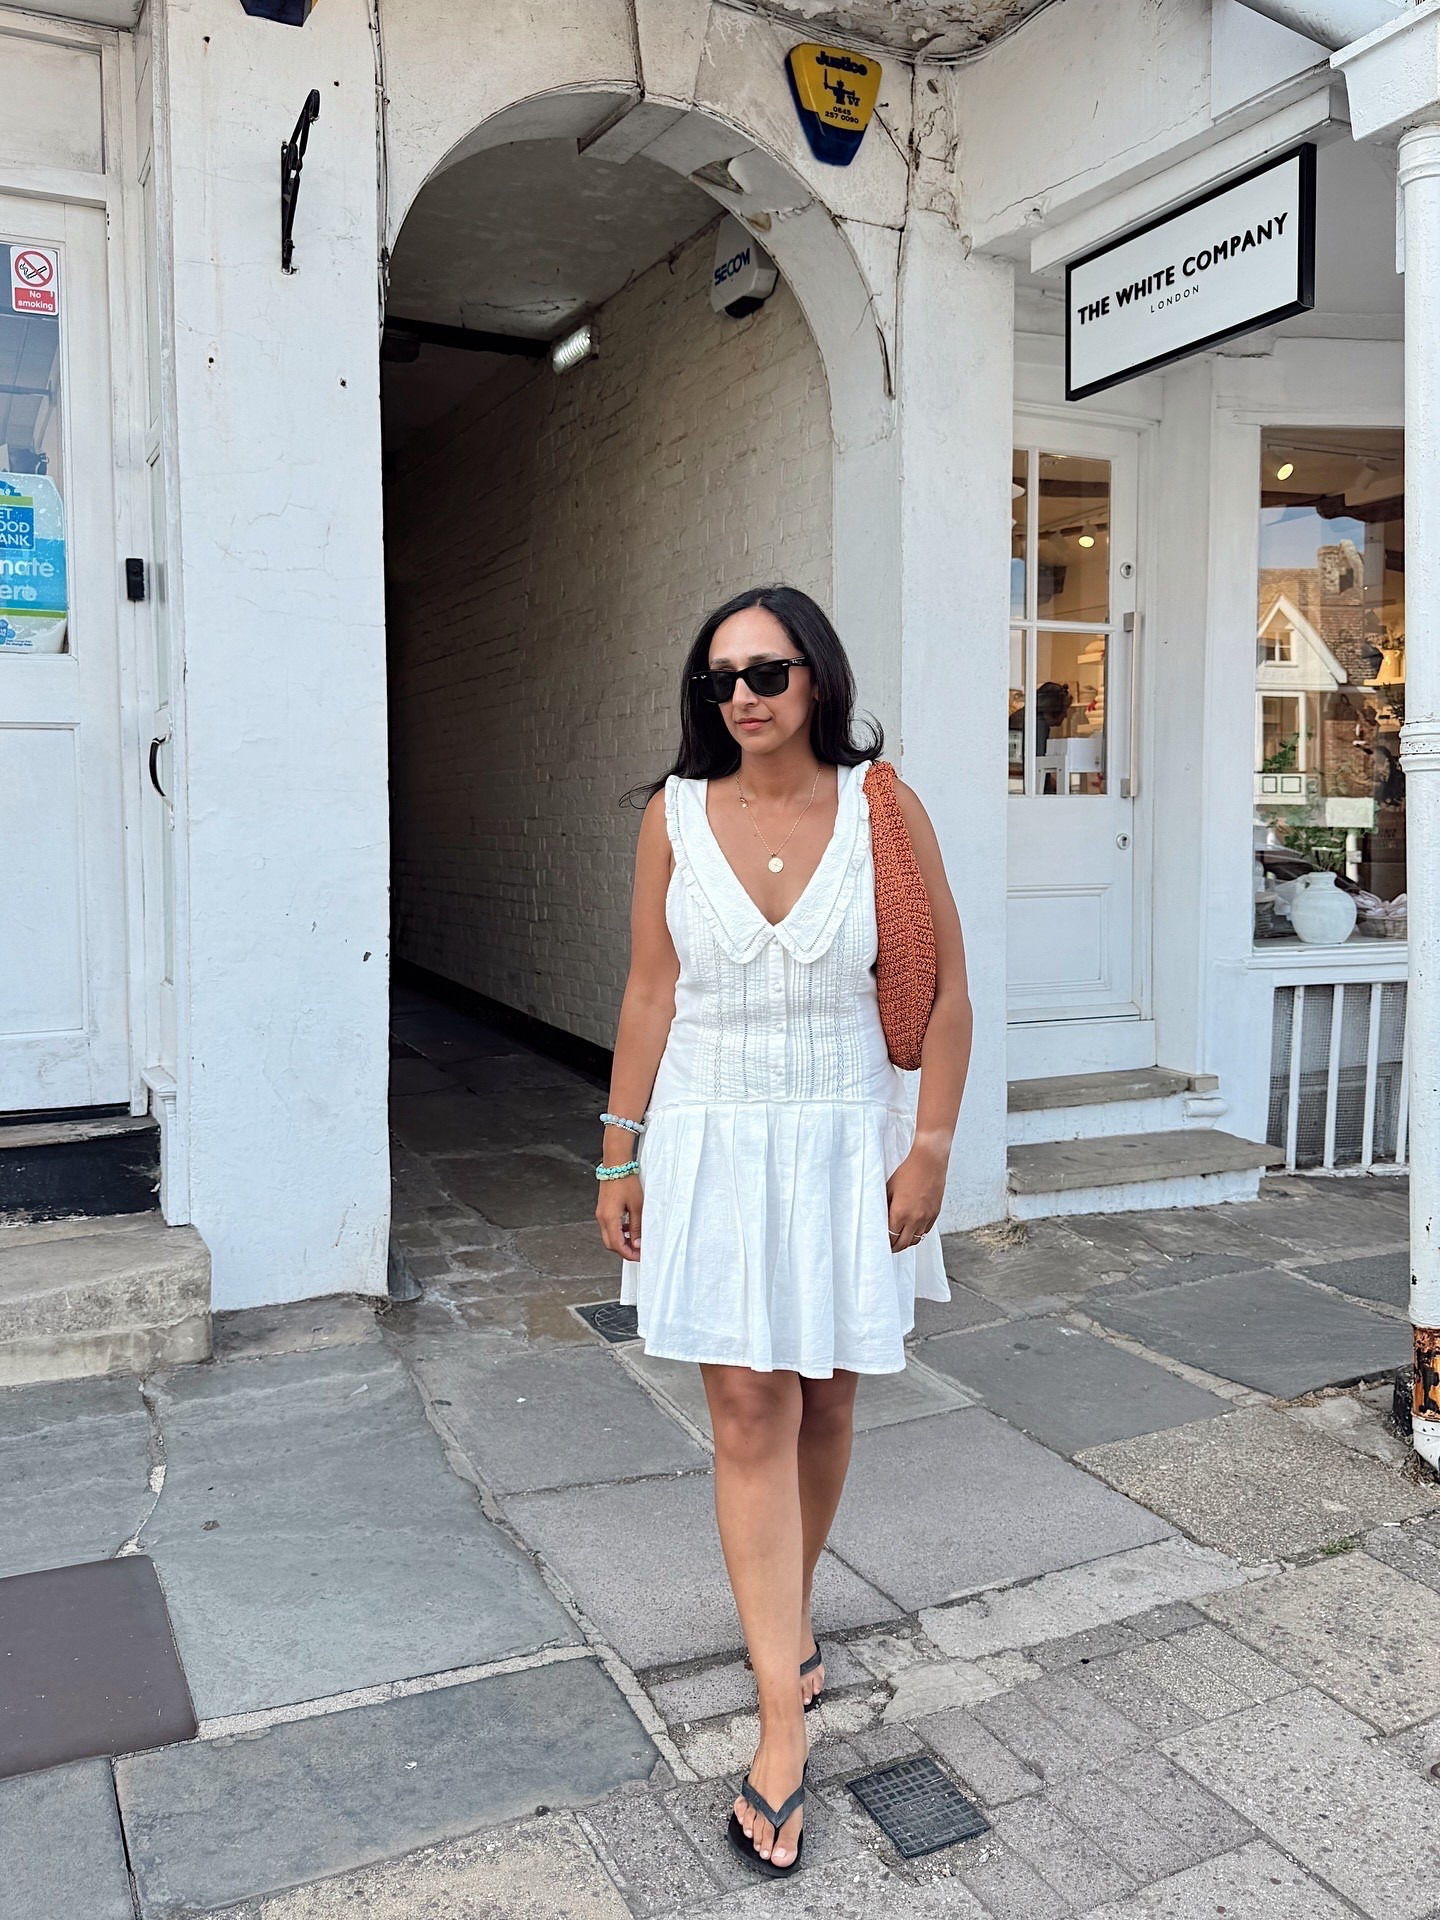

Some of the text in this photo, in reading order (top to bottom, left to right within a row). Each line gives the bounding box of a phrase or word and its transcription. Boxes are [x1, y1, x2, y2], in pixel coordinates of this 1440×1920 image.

[825, 111, 839, 119] 257
[833, 106, 851, 115] 0845
[714, 247, 750, 286] SECOM
[1077, 212, 1288, 325] THE WHITE COMPANY
[29, 290, 42, 298] No
[1150, 284, 1200, 313] LONDON
[17, 300, 54, 311] smoking
[0, 557, 55, 578] nate
